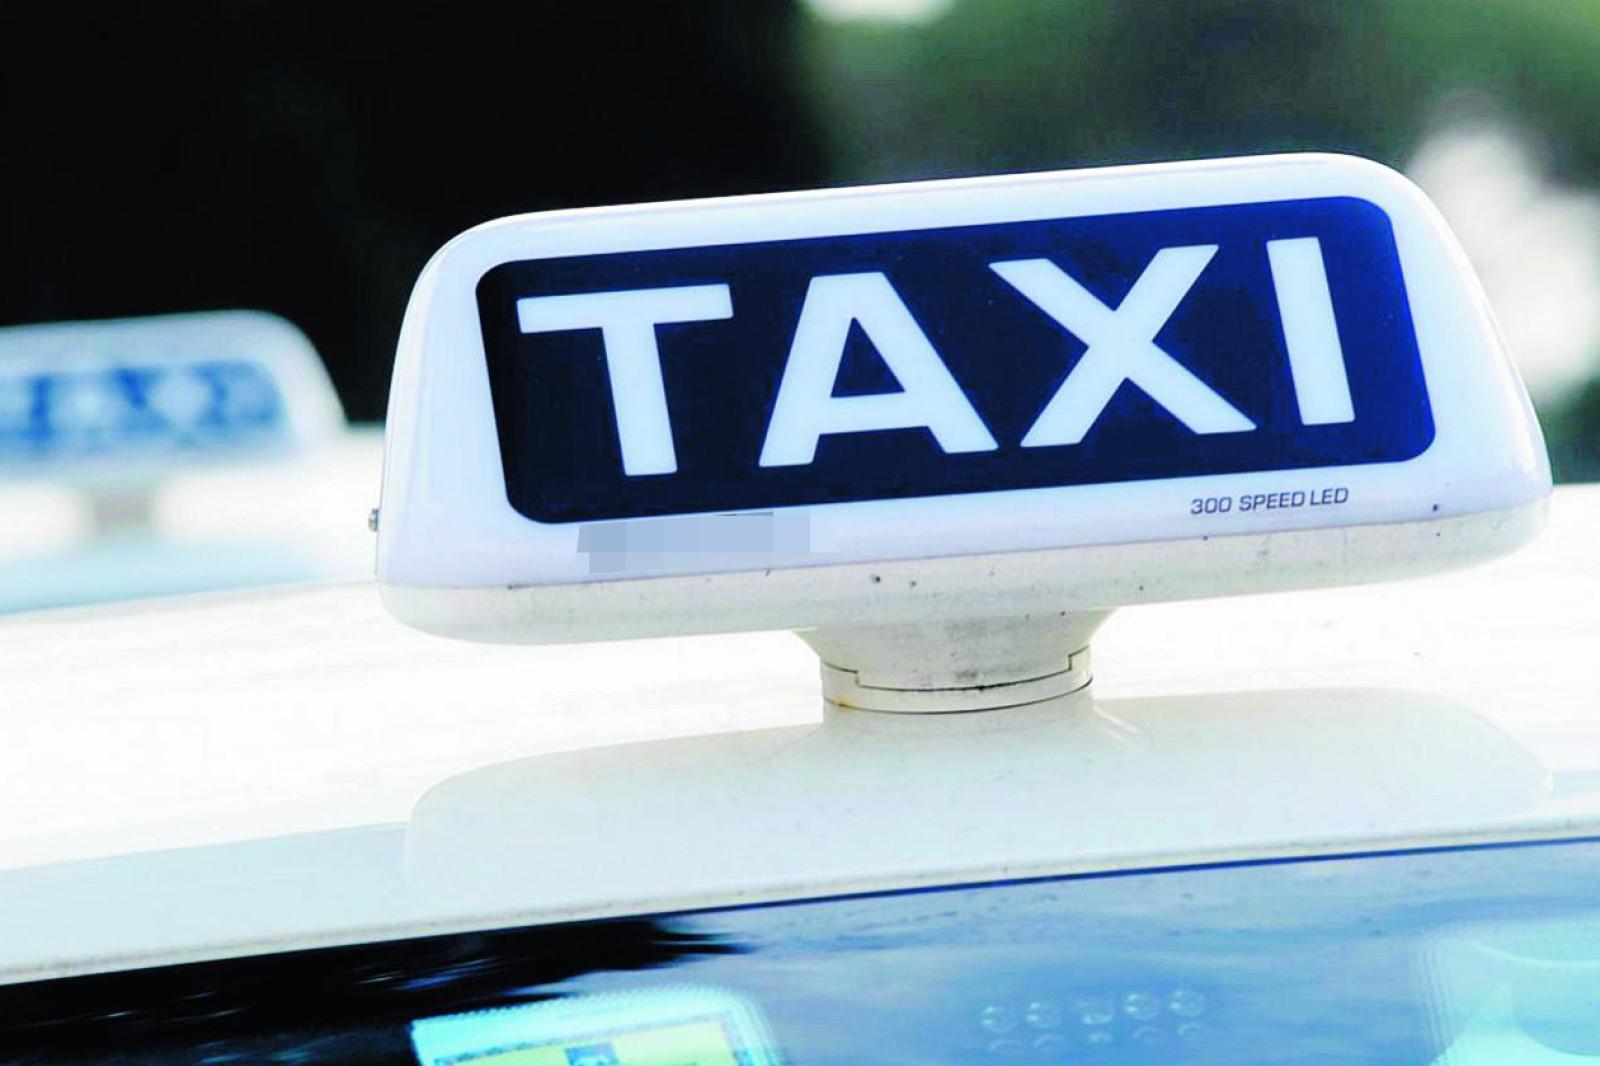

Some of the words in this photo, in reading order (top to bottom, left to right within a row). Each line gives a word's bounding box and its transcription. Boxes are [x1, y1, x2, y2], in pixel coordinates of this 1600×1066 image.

[517, 236, 1355, 477] TAXI
[1191, 497, 1232, 515] 300
[1239, 490, 1306, 512] SPEED
[1310, 487, 1349, 506] LED
